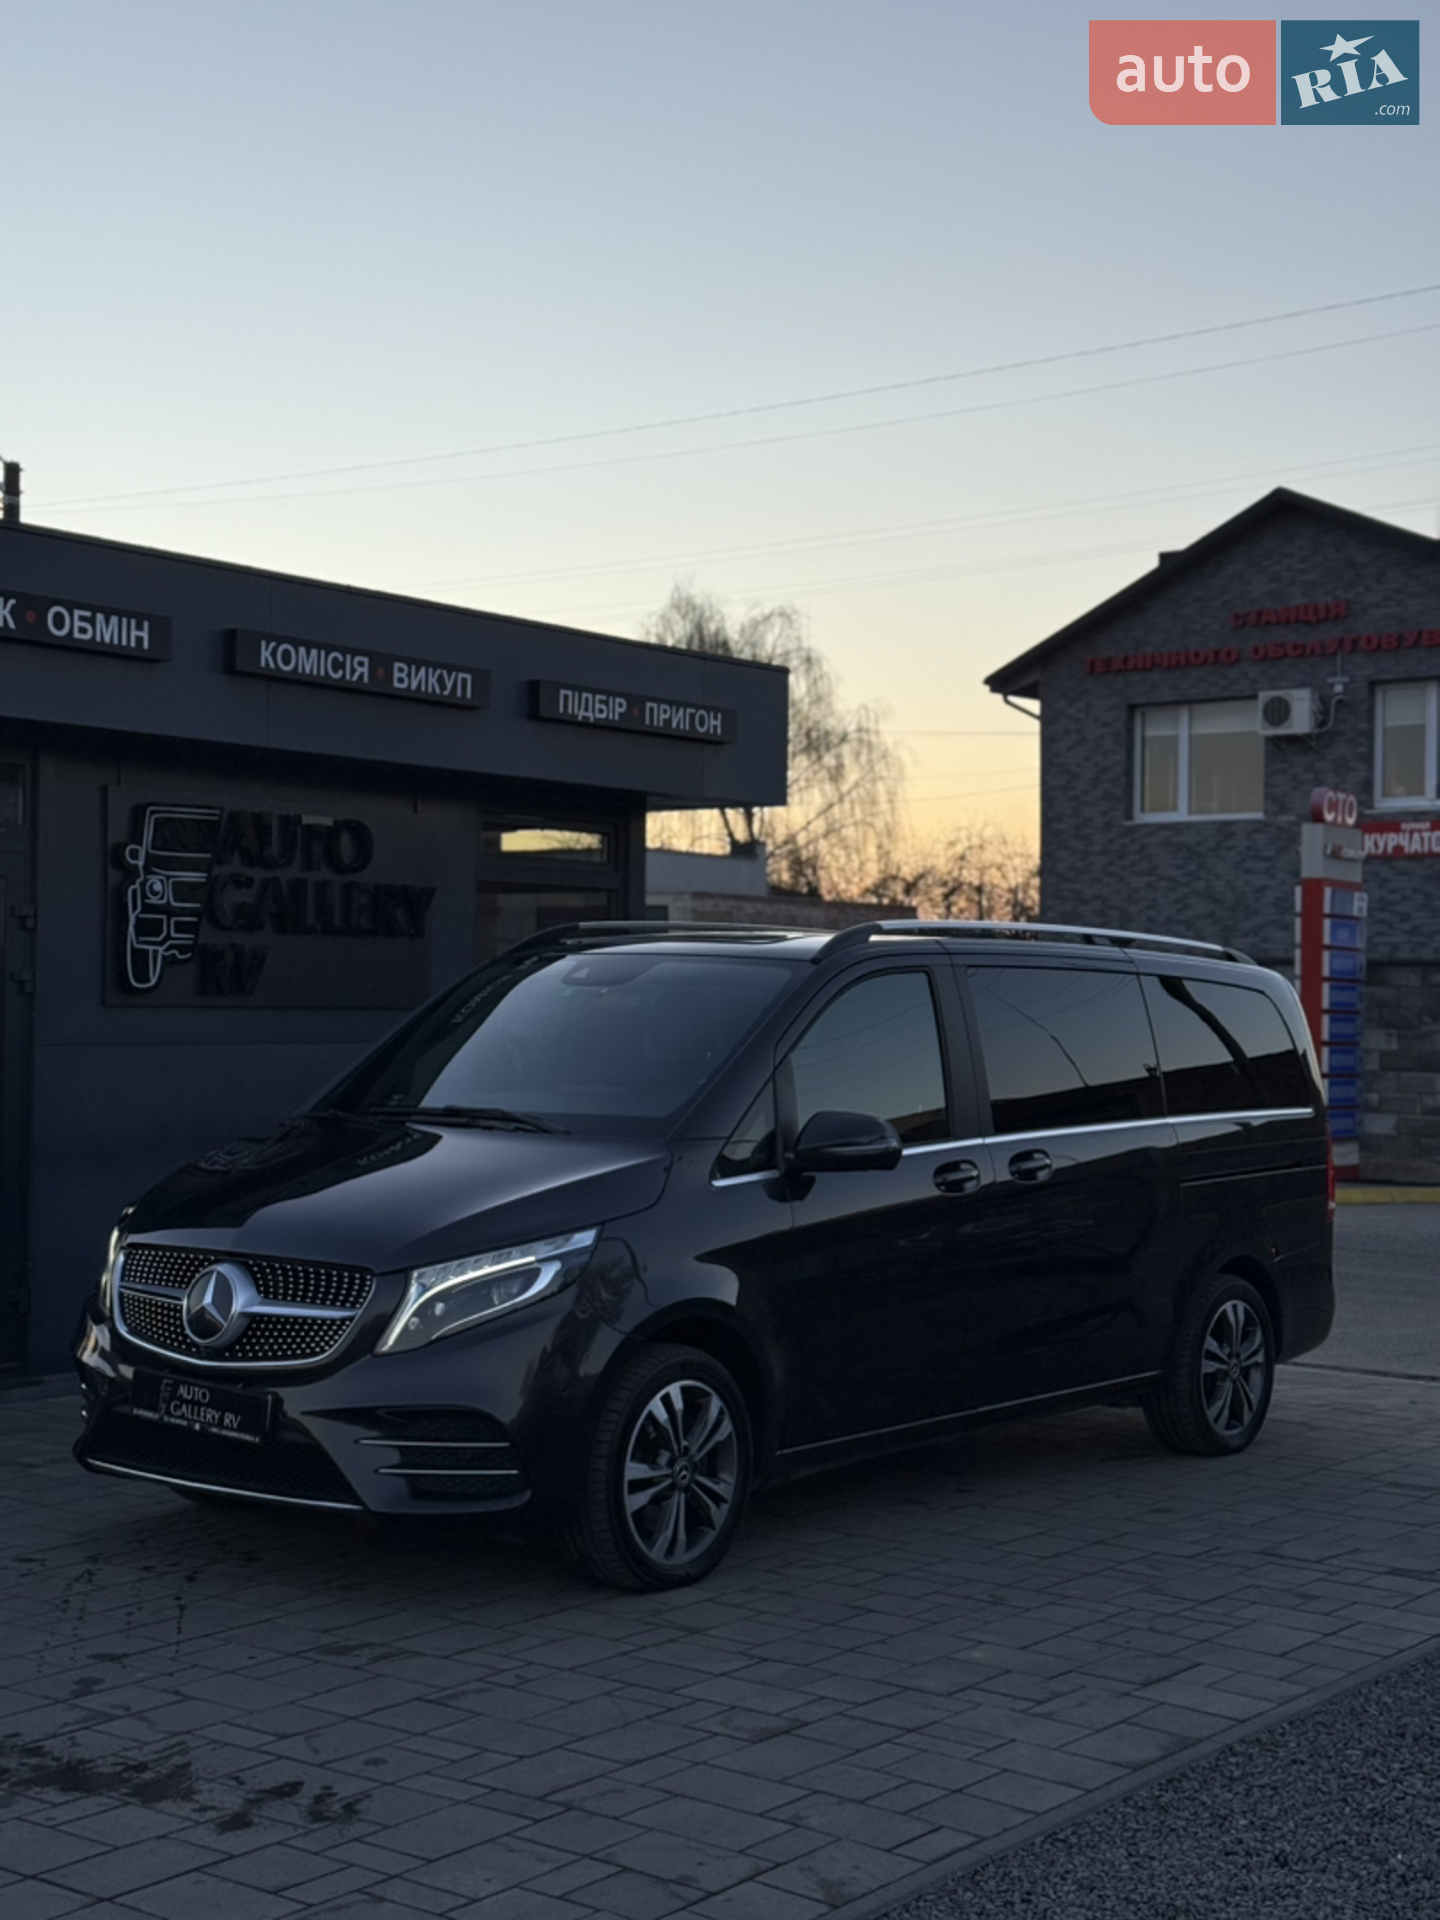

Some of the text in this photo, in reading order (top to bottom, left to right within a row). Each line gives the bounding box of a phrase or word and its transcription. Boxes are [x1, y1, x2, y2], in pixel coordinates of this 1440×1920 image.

[46, 605, 150, 650] ОБМІН
[1230, 601, 1348, 627] СТАНЦІЯ
[260, 639, 472, 699] КОМІСІЯ ВИКУП
[1085, 647, 1239, 673] ТЕХНІЧНОГО
[558, 688, 723, 736] ПІДБІР ПРИГОН
[1323, 791, 1358, 826] СТО
[215, 810, 374, 874] AUTO
[205, 873, 438, 938] GALLERY
[196, 943, 269, 995] RV
[169, 1400, 222, 1425] GALLERY
[223, 1411, 241, 1429] RV
[176, 1383, 211, 1404] AUTO
